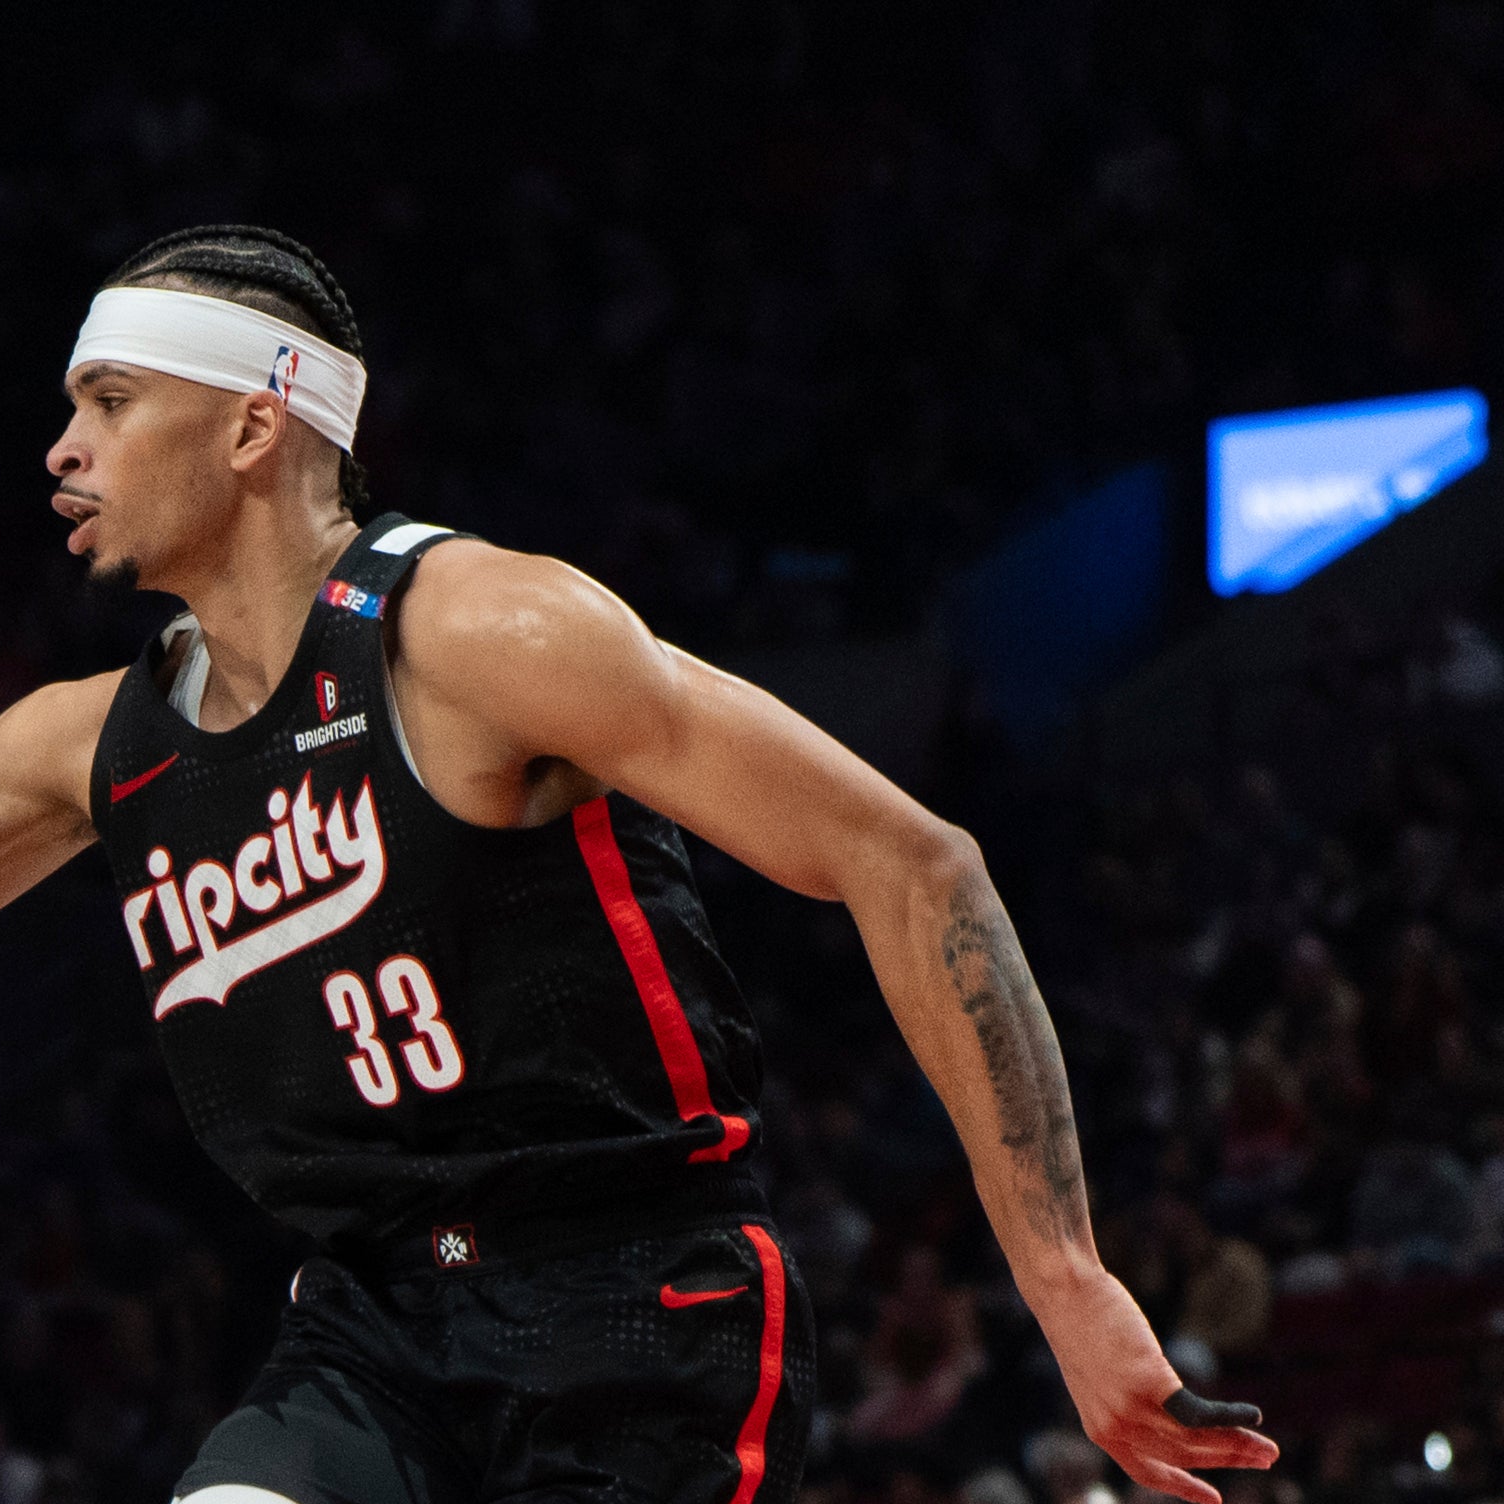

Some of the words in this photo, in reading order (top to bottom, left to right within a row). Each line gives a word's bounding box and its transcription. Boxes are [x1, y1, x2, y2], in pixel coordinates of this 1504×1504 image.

[340, 587, 368, 612] 32
[323, 679, 337, 712] B
[295, 711, 369, 753] BRIGHTSIDE
[322, 953, 466, 1109] 33
